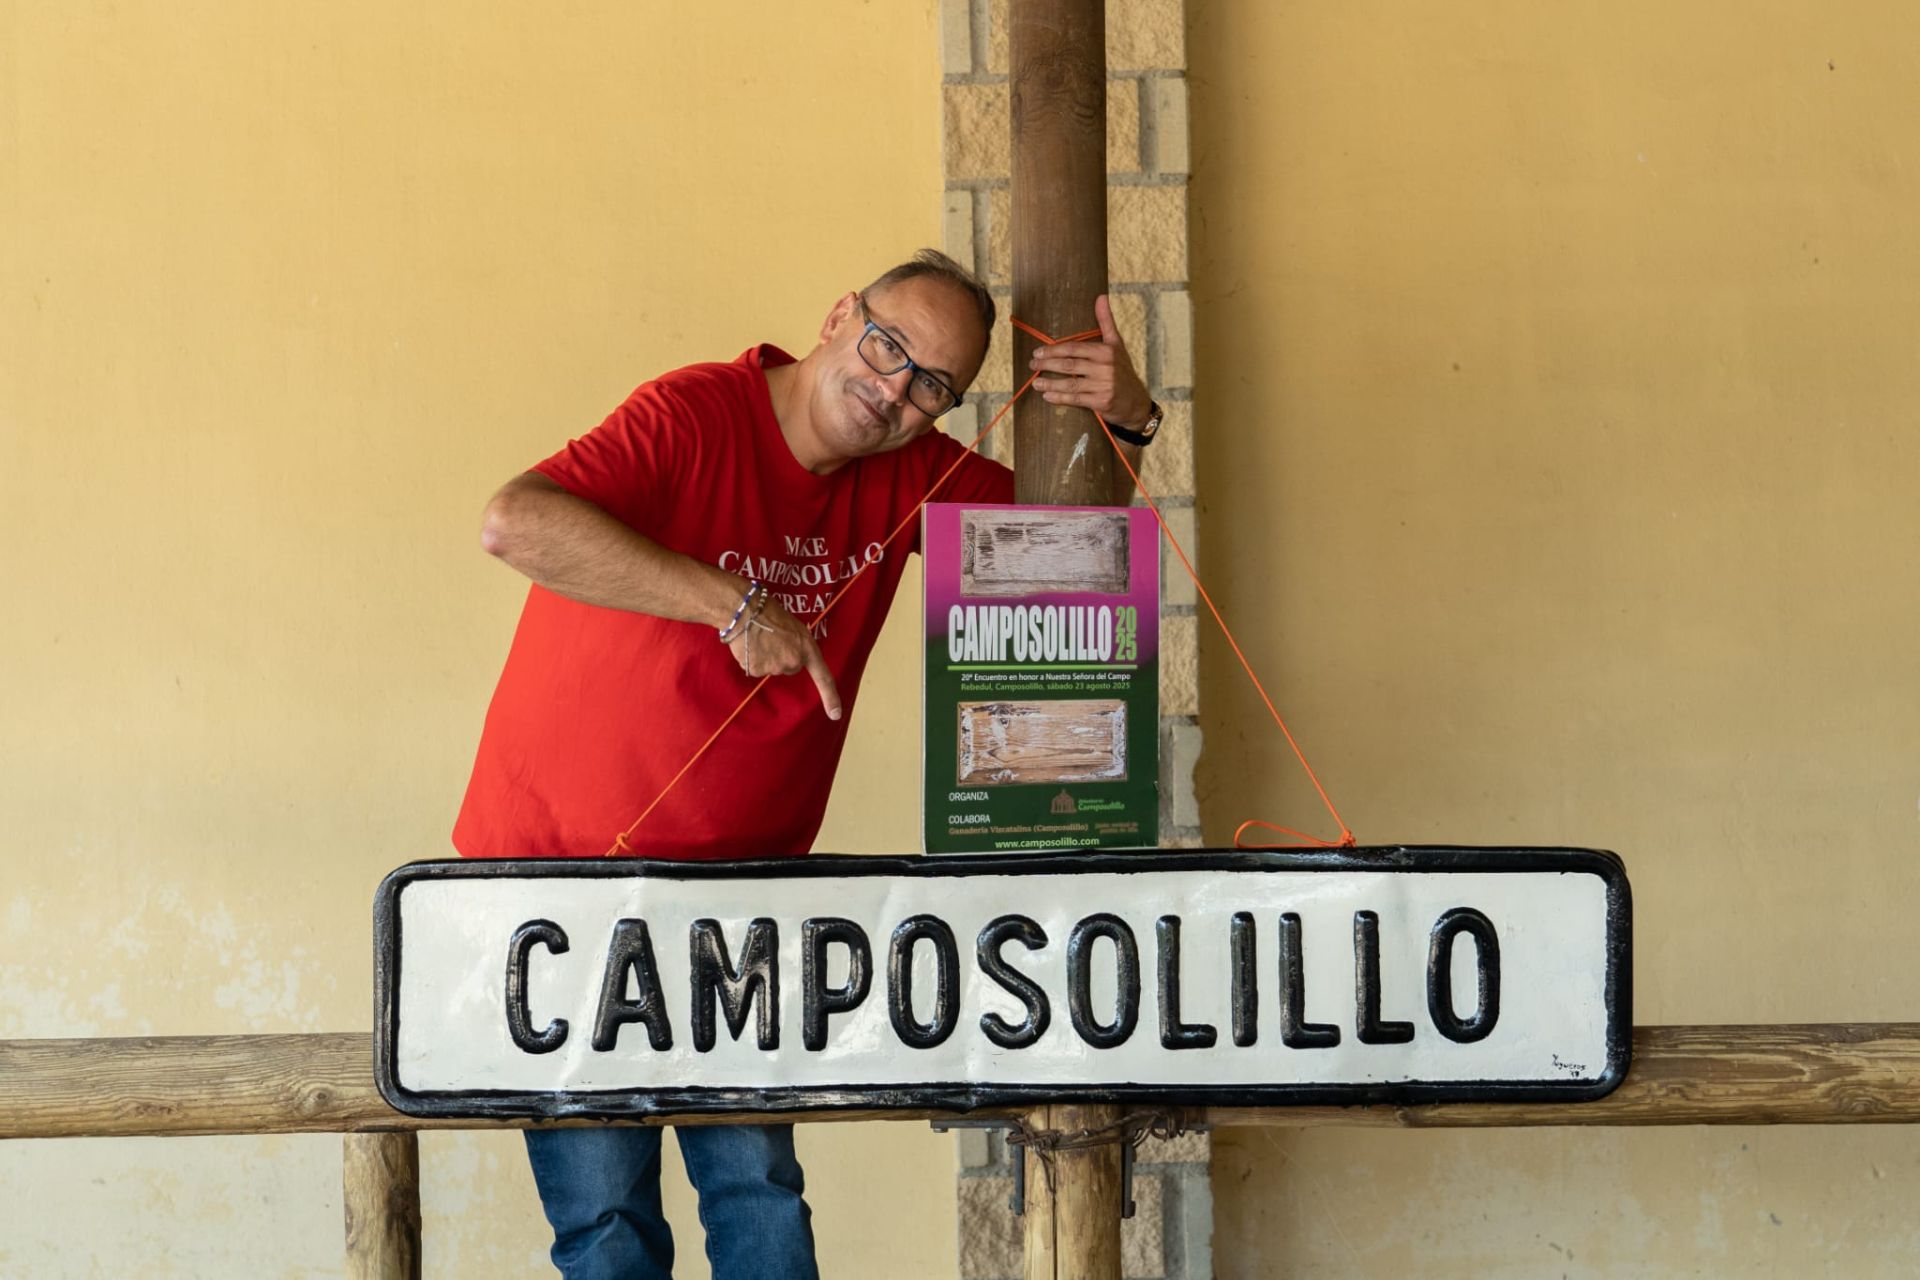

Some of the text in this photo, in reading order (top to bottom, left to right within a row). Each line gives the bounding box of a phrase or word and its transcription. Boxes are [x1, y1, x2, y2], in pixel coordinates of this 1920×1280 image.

[718, 541, 884, 586] CAMPOSOLLLO
[1115, 606, 1137, 633] 20
[948, 604, 1112, 662] CAMPOSOLILLO
[1115, 633, 1137, 661] 25
[974, 673, 1007, 681] Encuentro
[1018, 673, 1038, 681] honor
[1072, 672, 1095, 680] Señora
[1096, 672, 1106, 680] del
[1107, 672, 1131, 681] Campo
[1047, 682, 1073, 690] sábado
[1086, 682, 1111, 691] agosto
[948, 791, 989, 802] ORGANIZA
[948, 814, 991, 825] COLABORA
[995, 837, 1100, 849] www.camposolillo.com
[505, 906, 1500, 1053] CAMPOSOLILLO
